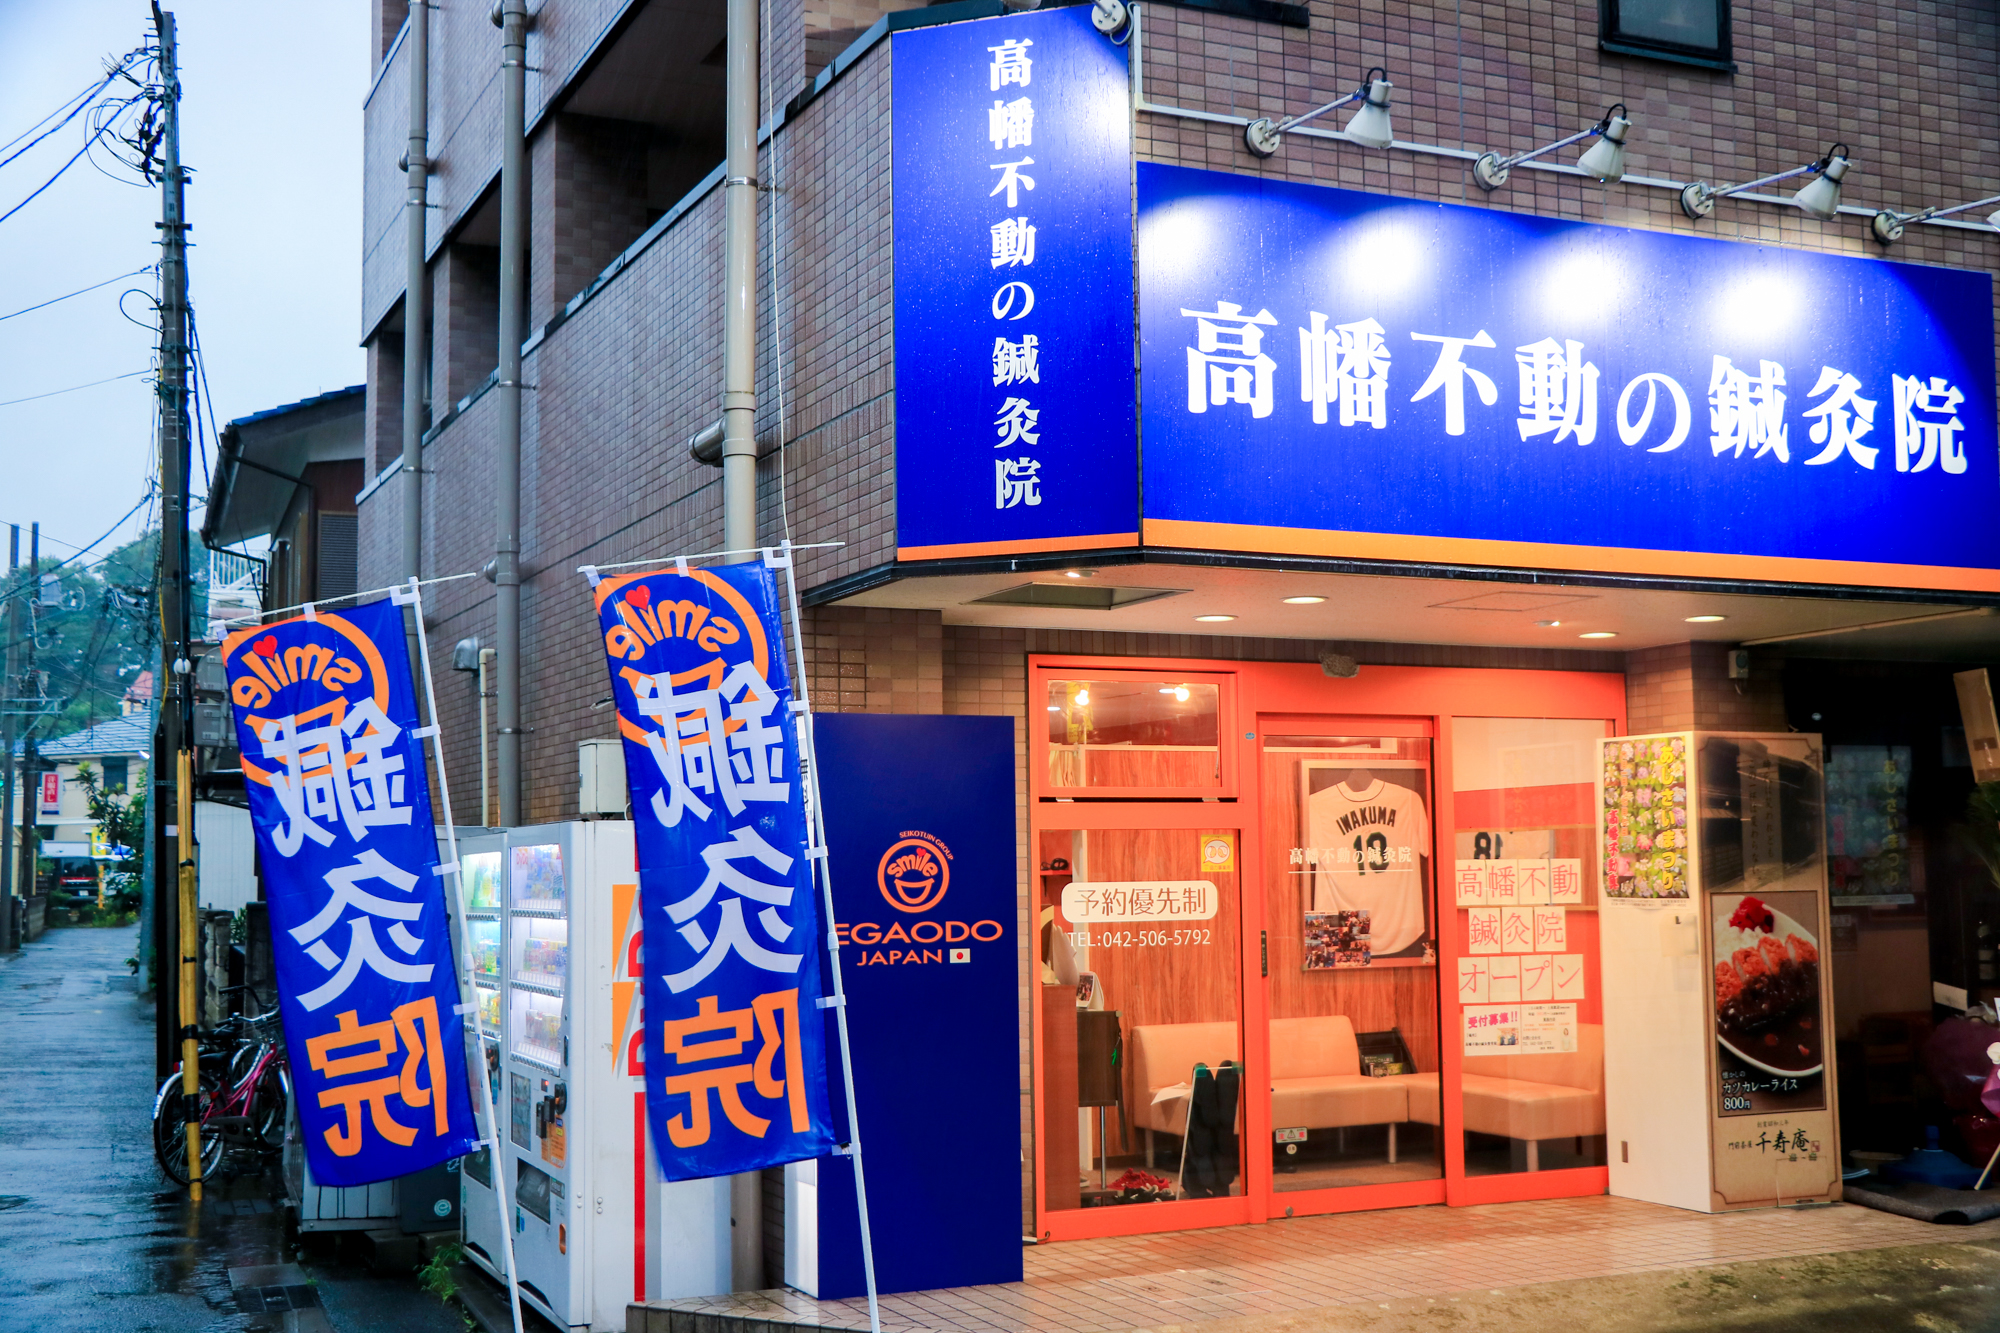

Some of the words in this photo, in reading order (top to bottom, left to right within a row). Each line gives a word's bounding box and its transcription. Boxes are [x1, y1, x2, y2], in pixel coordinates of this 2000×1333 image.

[987, 38, 1042, 510] 高幡不動の鍼灸院
[1180, 300, 1968, 475] 高幡不動の鍼灸院
[1336, 805, 1397, 836] IWAKUMA
[1659, 745, 1676, 890] あじさいまつり
[1883, 760, 1900, 887] あじさいまつり
[899, 830, 936, 842] SEIKOTUIN
[935, 838, 954, 861] GROUP
[1289, 846, 1413, 865] 高幡不動の鍼灸院
[887, 850, 939, 878] smile
[1456, 864, 1578, 899] 高幡不動
[1074, 887, 1207, 917] 予約優先制
[1068, 929, 1211, 948] TEL:042-506-5792
[1469, 912, 1564, 947] 鍼灸院
[856, 949, 943, 967] JAPAN
[1459, 960, 1581, 994] オープン
[1723, 1078, 1798, 1095] カツカレーライス
[1724, 1096, 1751, 1110] 800円
[1755, 1128, 1810, 1154] 千寿庵
